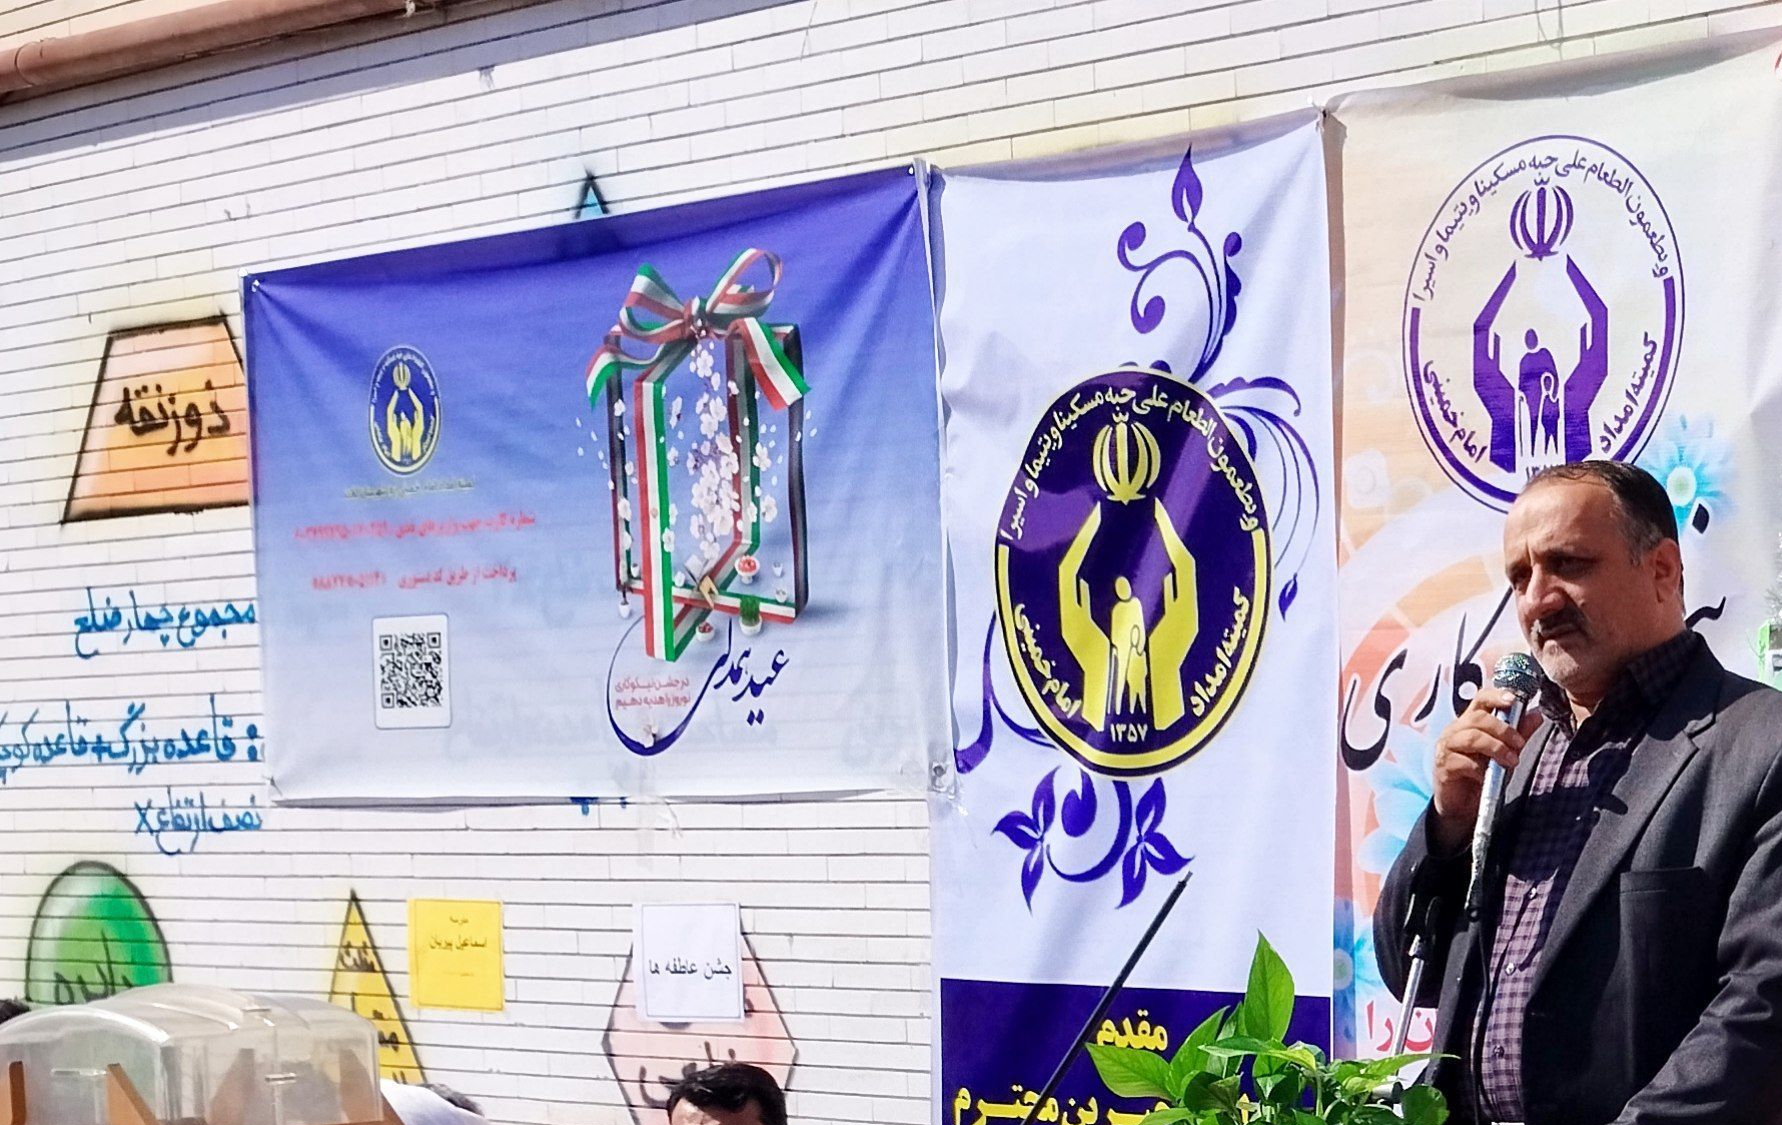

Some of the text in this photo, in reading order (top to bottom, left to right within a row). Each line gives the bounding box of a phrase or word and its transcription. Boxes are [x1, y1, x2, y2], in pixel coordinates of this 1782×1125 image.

[114, 379, 231, 456] ذوزنقه
[164, 693, 236, 762] قاعده
[649, 958, 732, 981] جشن عاطفه ها
[1096, 1009, 1167, 1051] مقدم
